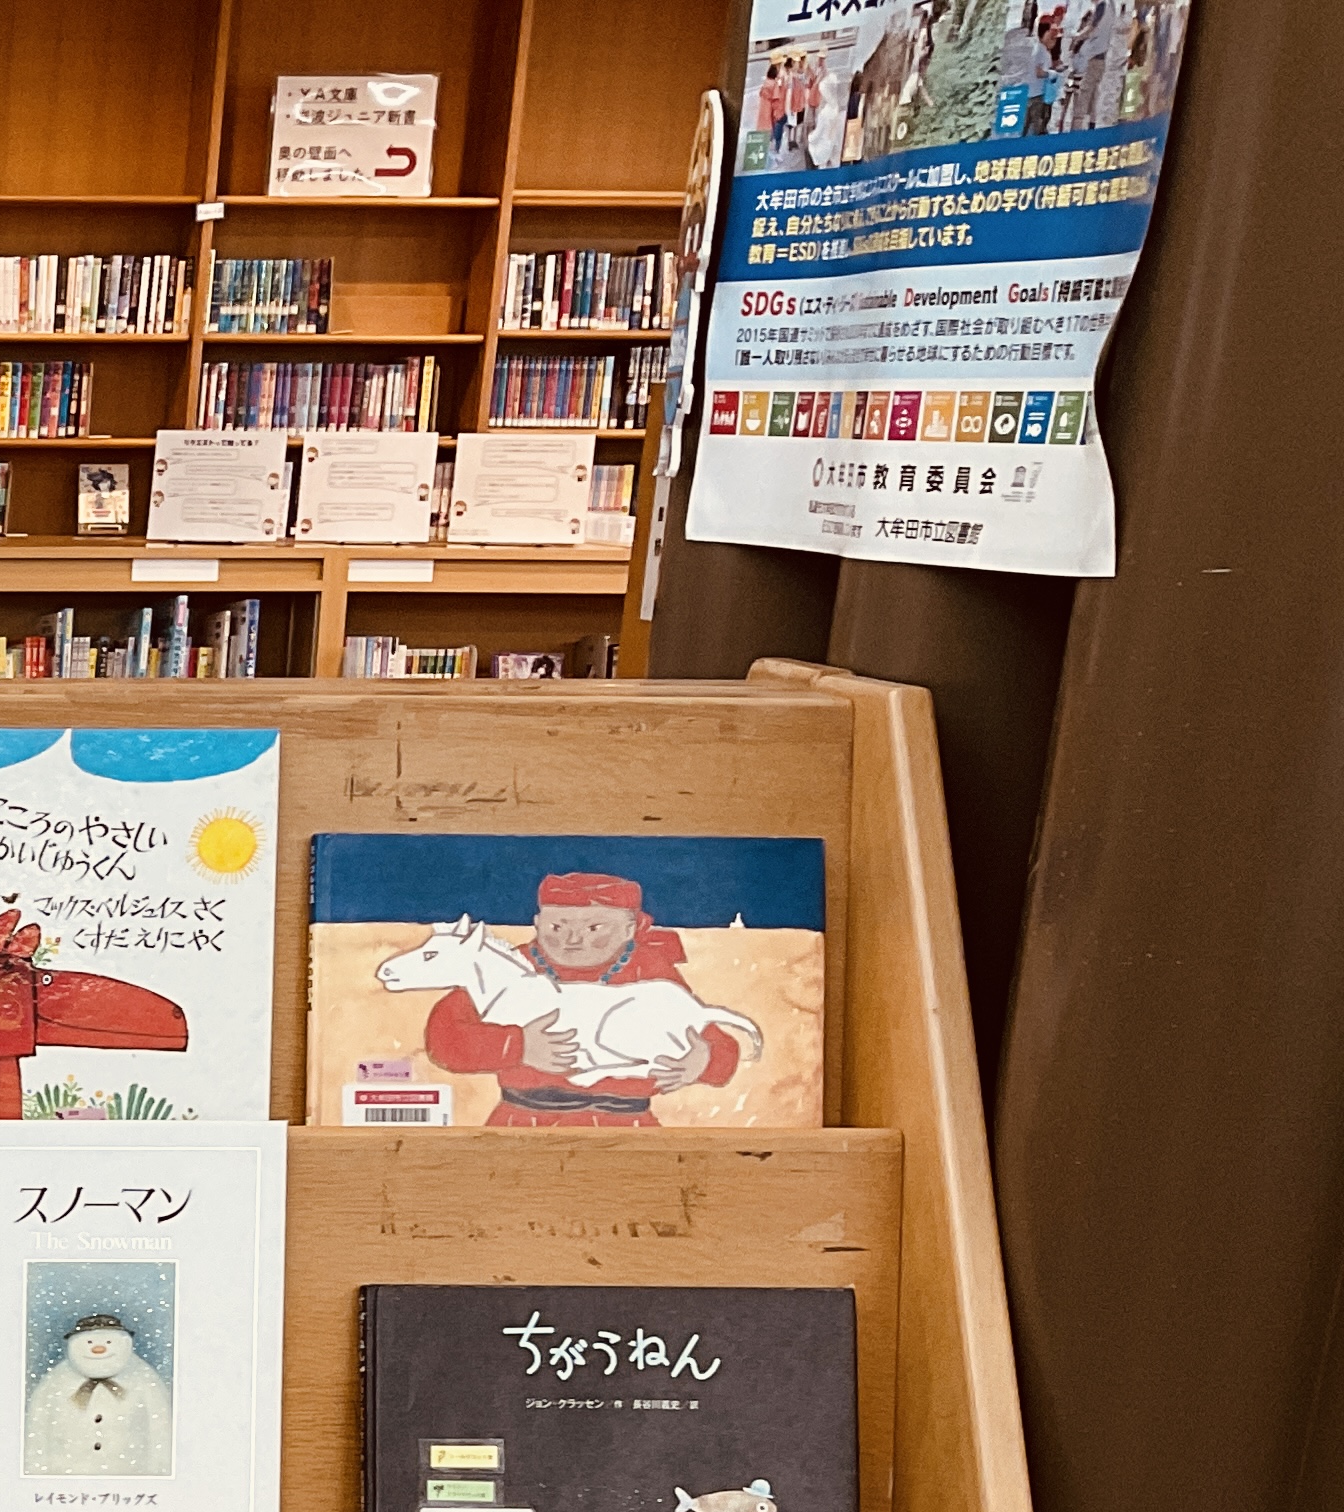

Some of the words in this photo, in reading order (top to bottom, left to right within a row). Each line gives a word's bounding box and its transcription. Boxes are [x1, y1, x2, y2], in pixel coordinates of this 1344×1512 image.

[740, 290, 796, 316] SDGs
[903, 286, 998, 308] Development
[1007, 283, 1049, 303] Goals
[191, 896, 228, 923] さく
[13, 1186, 193, 1224] スノーマン
[30, 1230, 70, 1252] The
[76, 1231, 173, 1252] Snowman
[502, 1310, 722, 1382] ちがうねん
